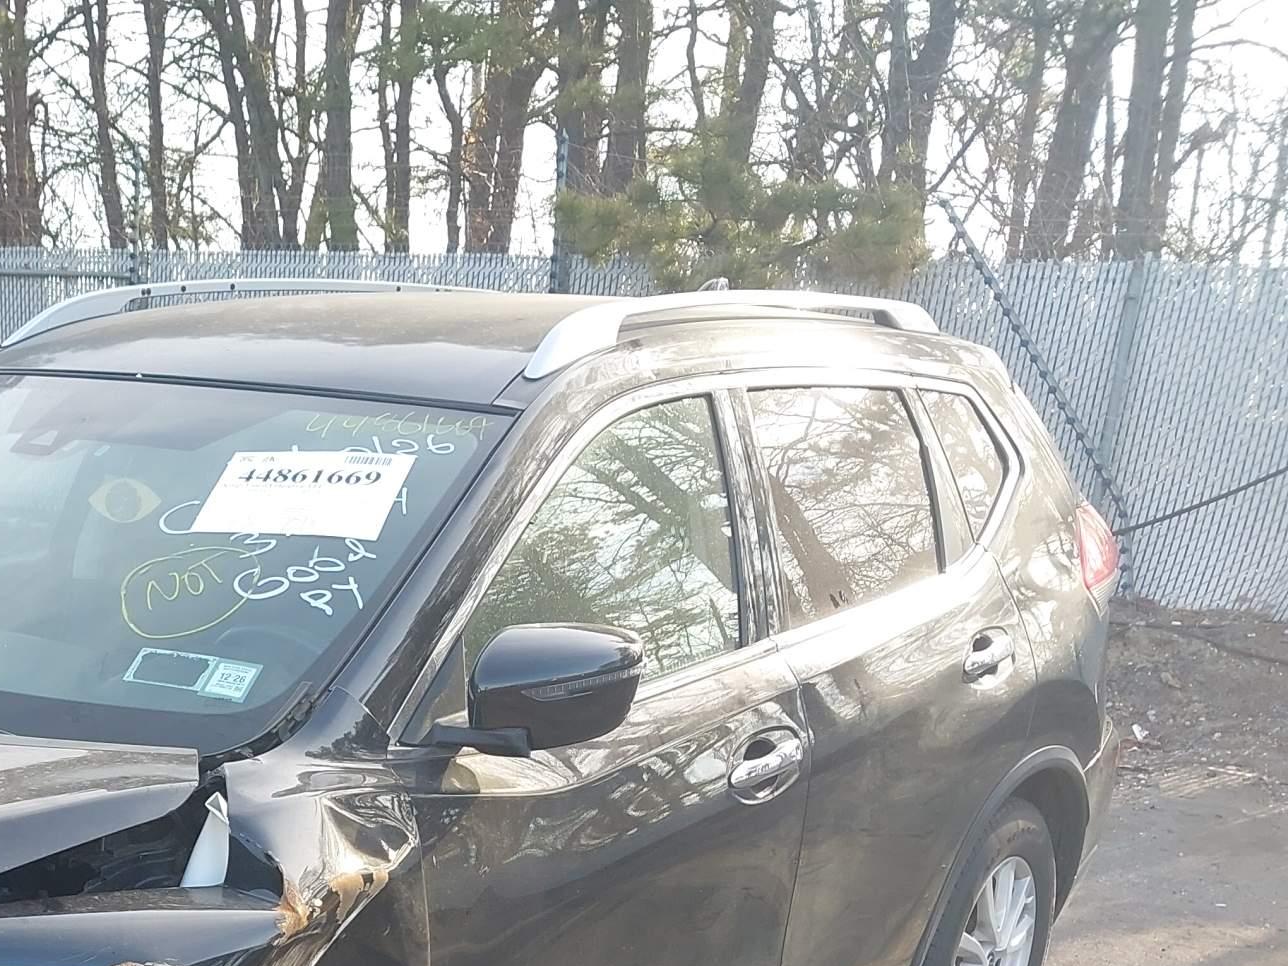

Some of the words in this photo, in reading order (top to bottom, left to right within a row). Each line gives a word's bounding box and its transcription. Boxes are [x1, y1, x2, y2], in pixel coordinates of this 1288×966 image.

[238, 468, 382, 486] 44861669
[146, 550, 227, 611] NOT
[220, 672, 231, 681] 12
